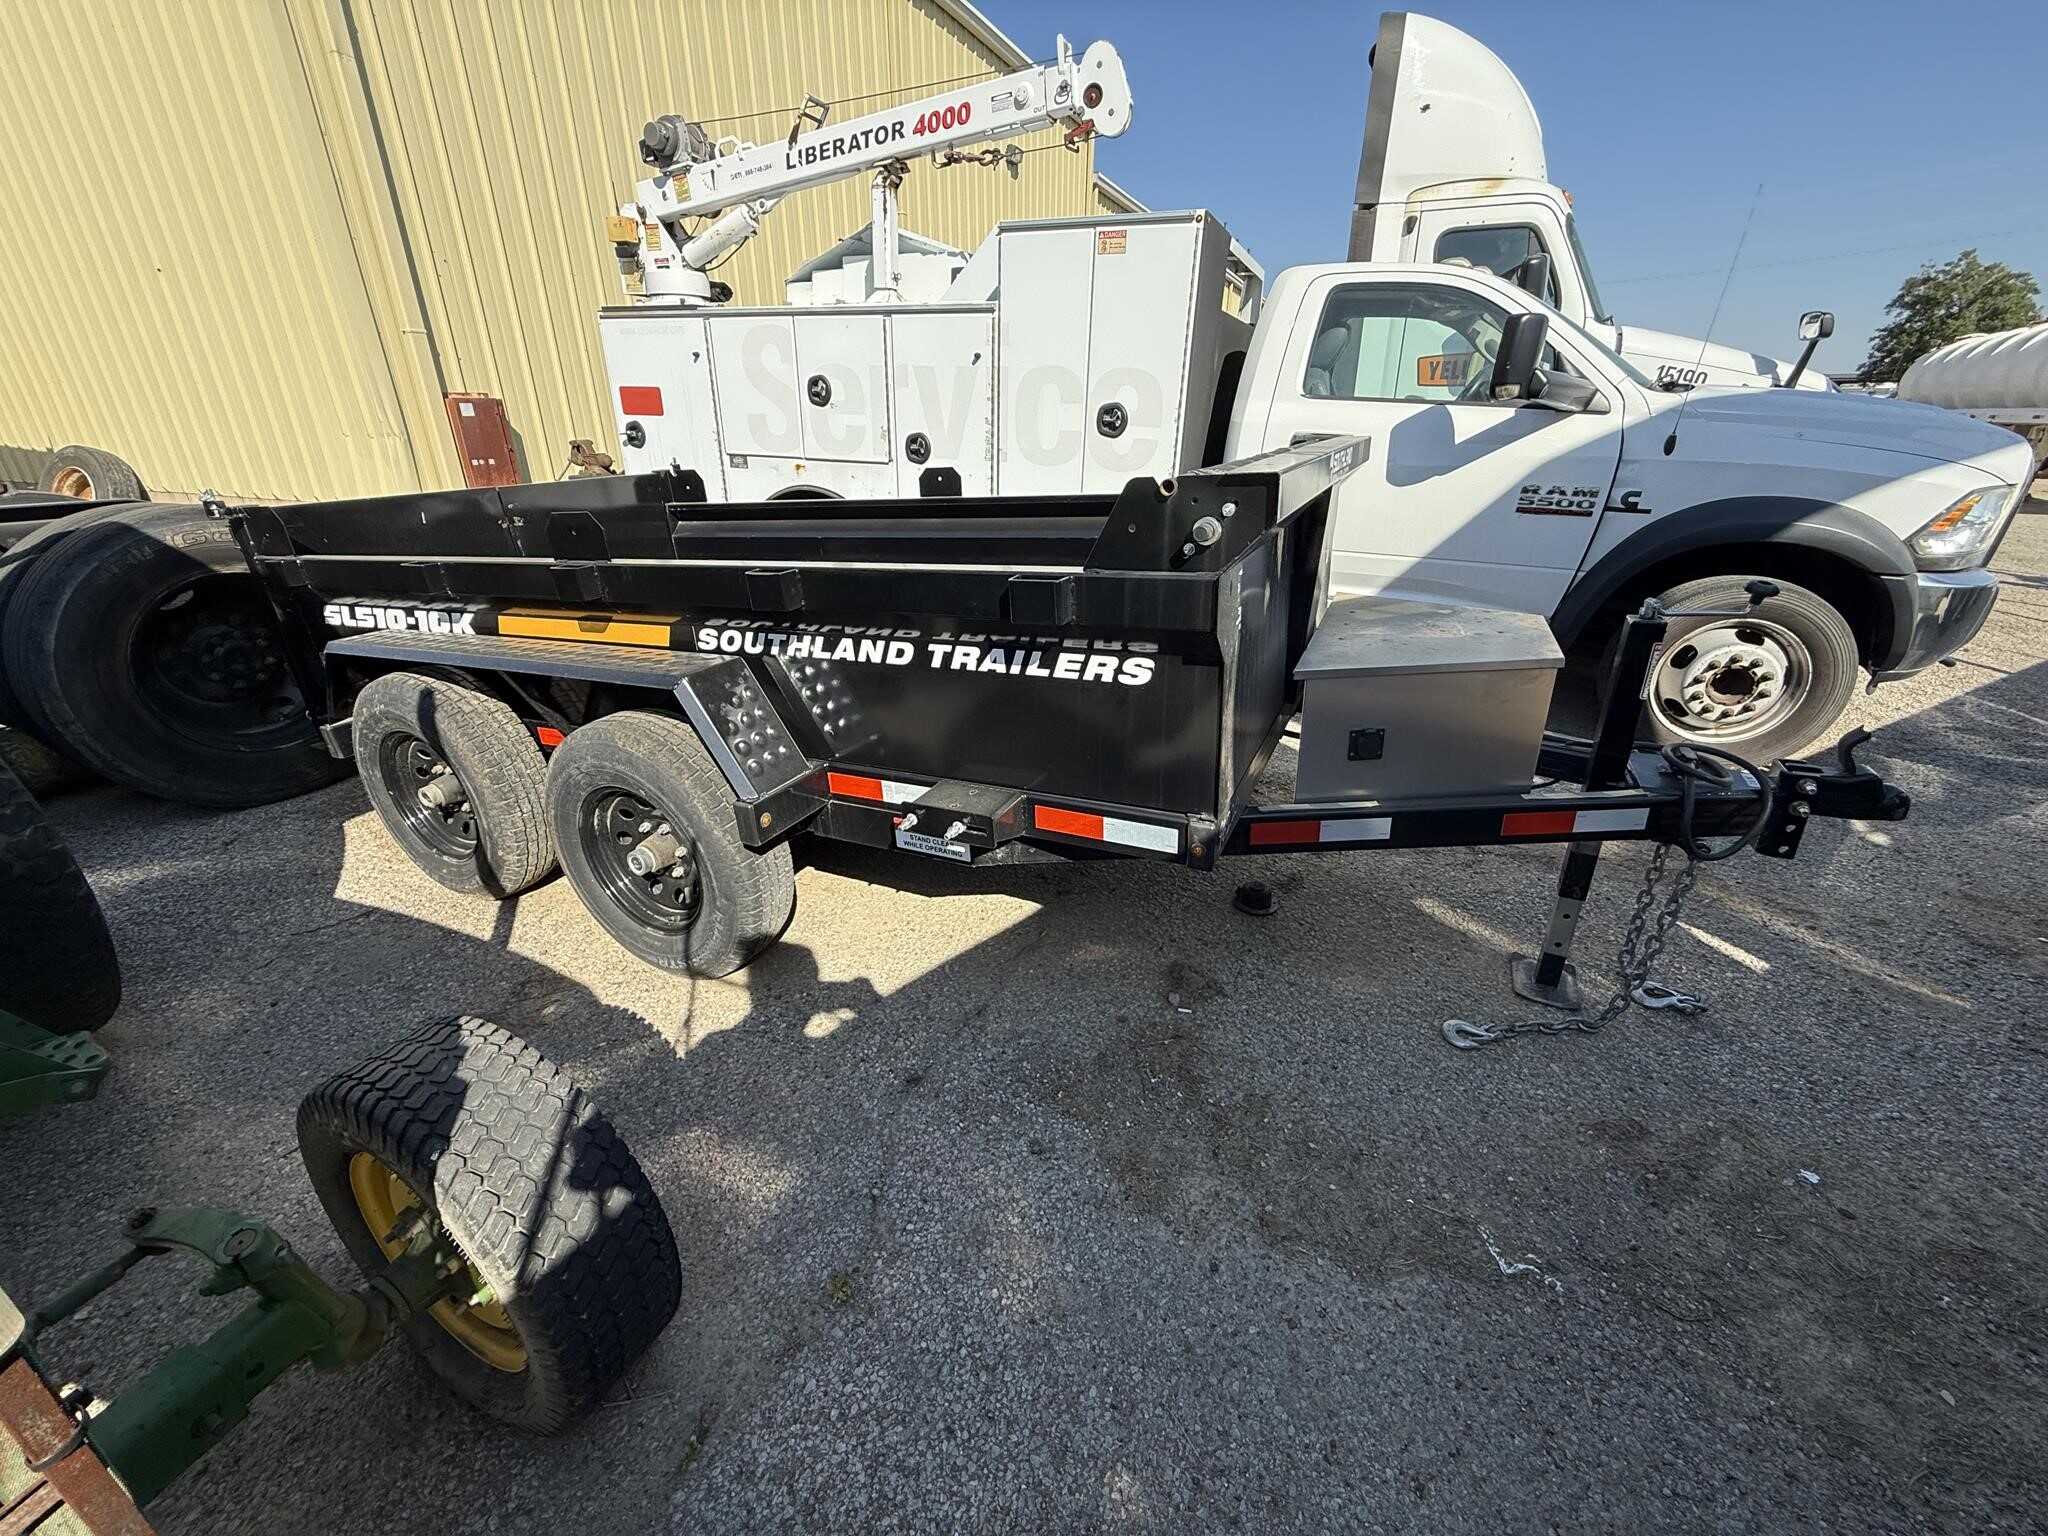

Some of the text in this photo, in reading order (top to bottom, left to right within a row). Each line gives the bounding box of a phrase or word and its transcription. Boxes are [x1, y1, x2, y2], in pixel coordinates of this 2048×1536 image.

[785, 101, 972, 170] LIBERATOR 4000
[741, 324, 1162, 473] Service
[1520, 484, 1600, 498] RAM
[1517, 496, 1596, 509] 5500
[697, 628, 1155, 686] SOUTHLAND TRAILERS
[910, 834, 930, 844] STAND
[903, 840, 963, 857] WHILE OPERATING
